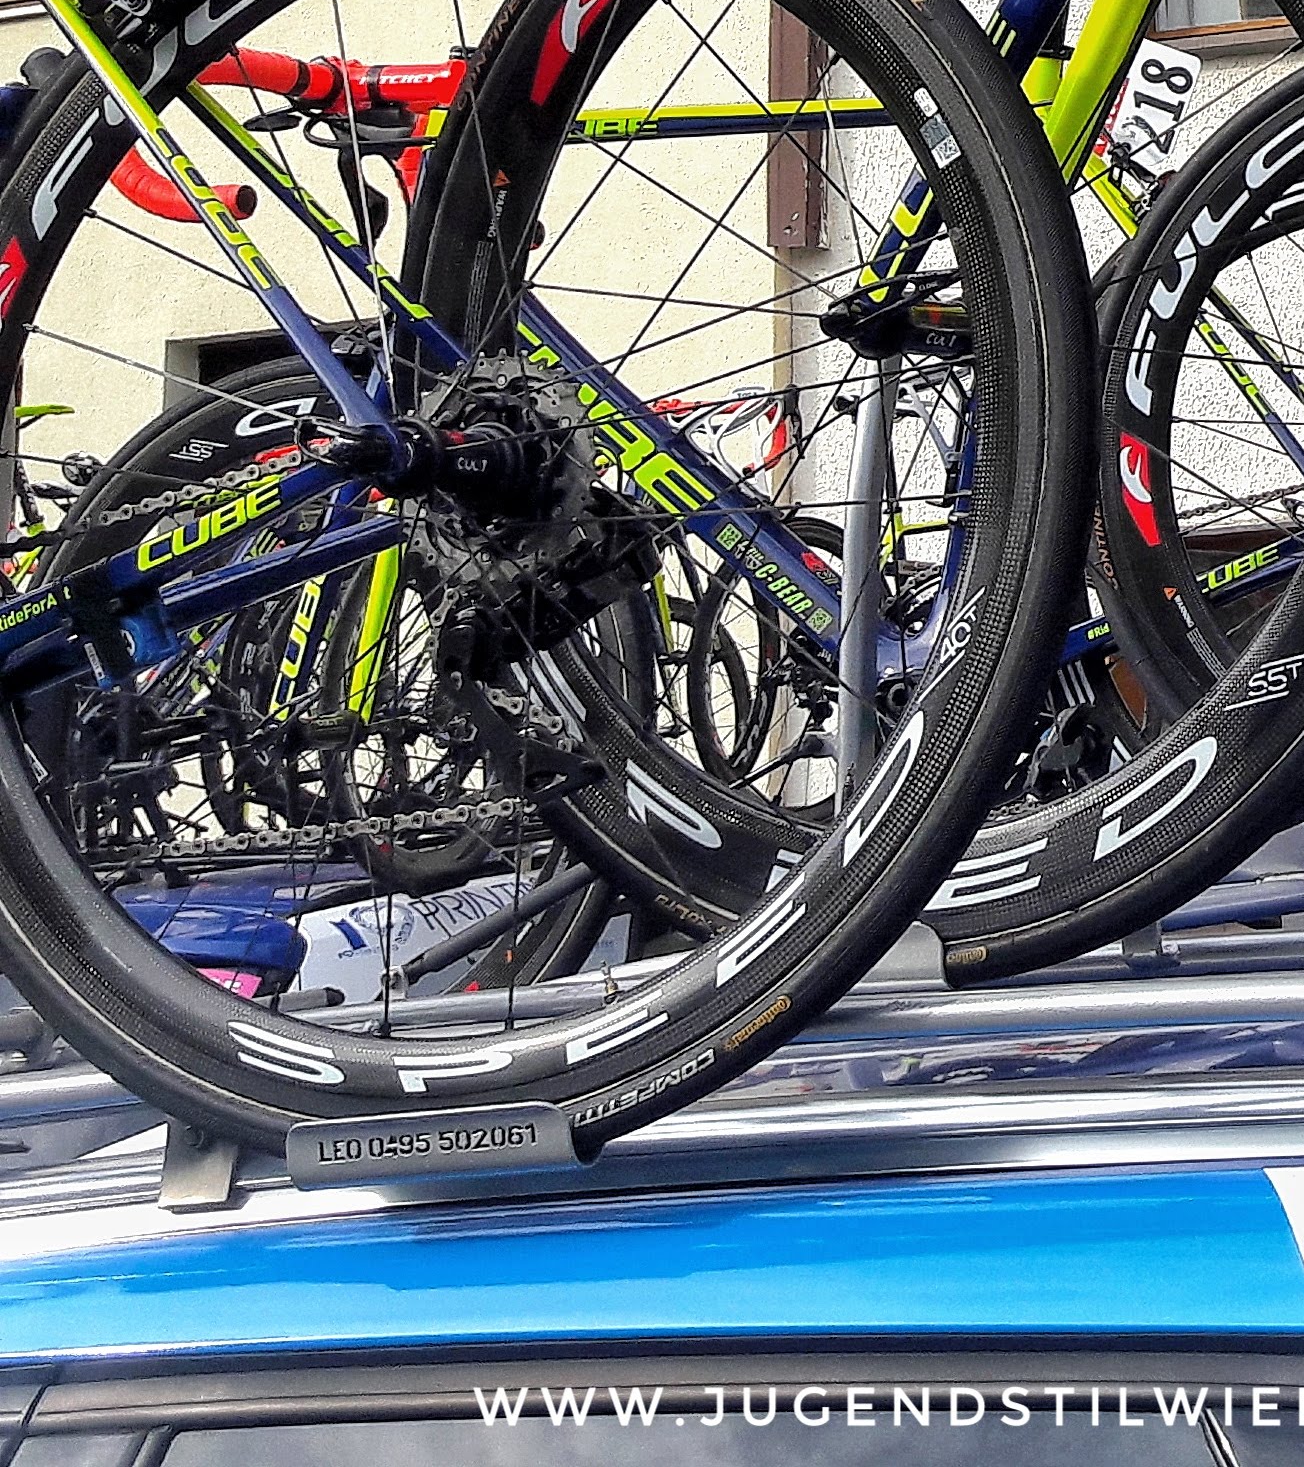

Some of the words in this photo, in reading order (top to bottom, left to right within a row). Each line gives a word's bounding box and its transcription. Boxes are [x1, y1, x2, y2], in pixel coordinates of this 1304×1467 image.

[1121, 58, 1193, 154] 218
[137, 480, 286, 572] CUBE
[228, 709, 924, 1092] SPEED
[317, 1137, 362, 1164] LEO
[367, 1132, 431, 1159] 0495
[437, 1122, 539, 1156] 502061
